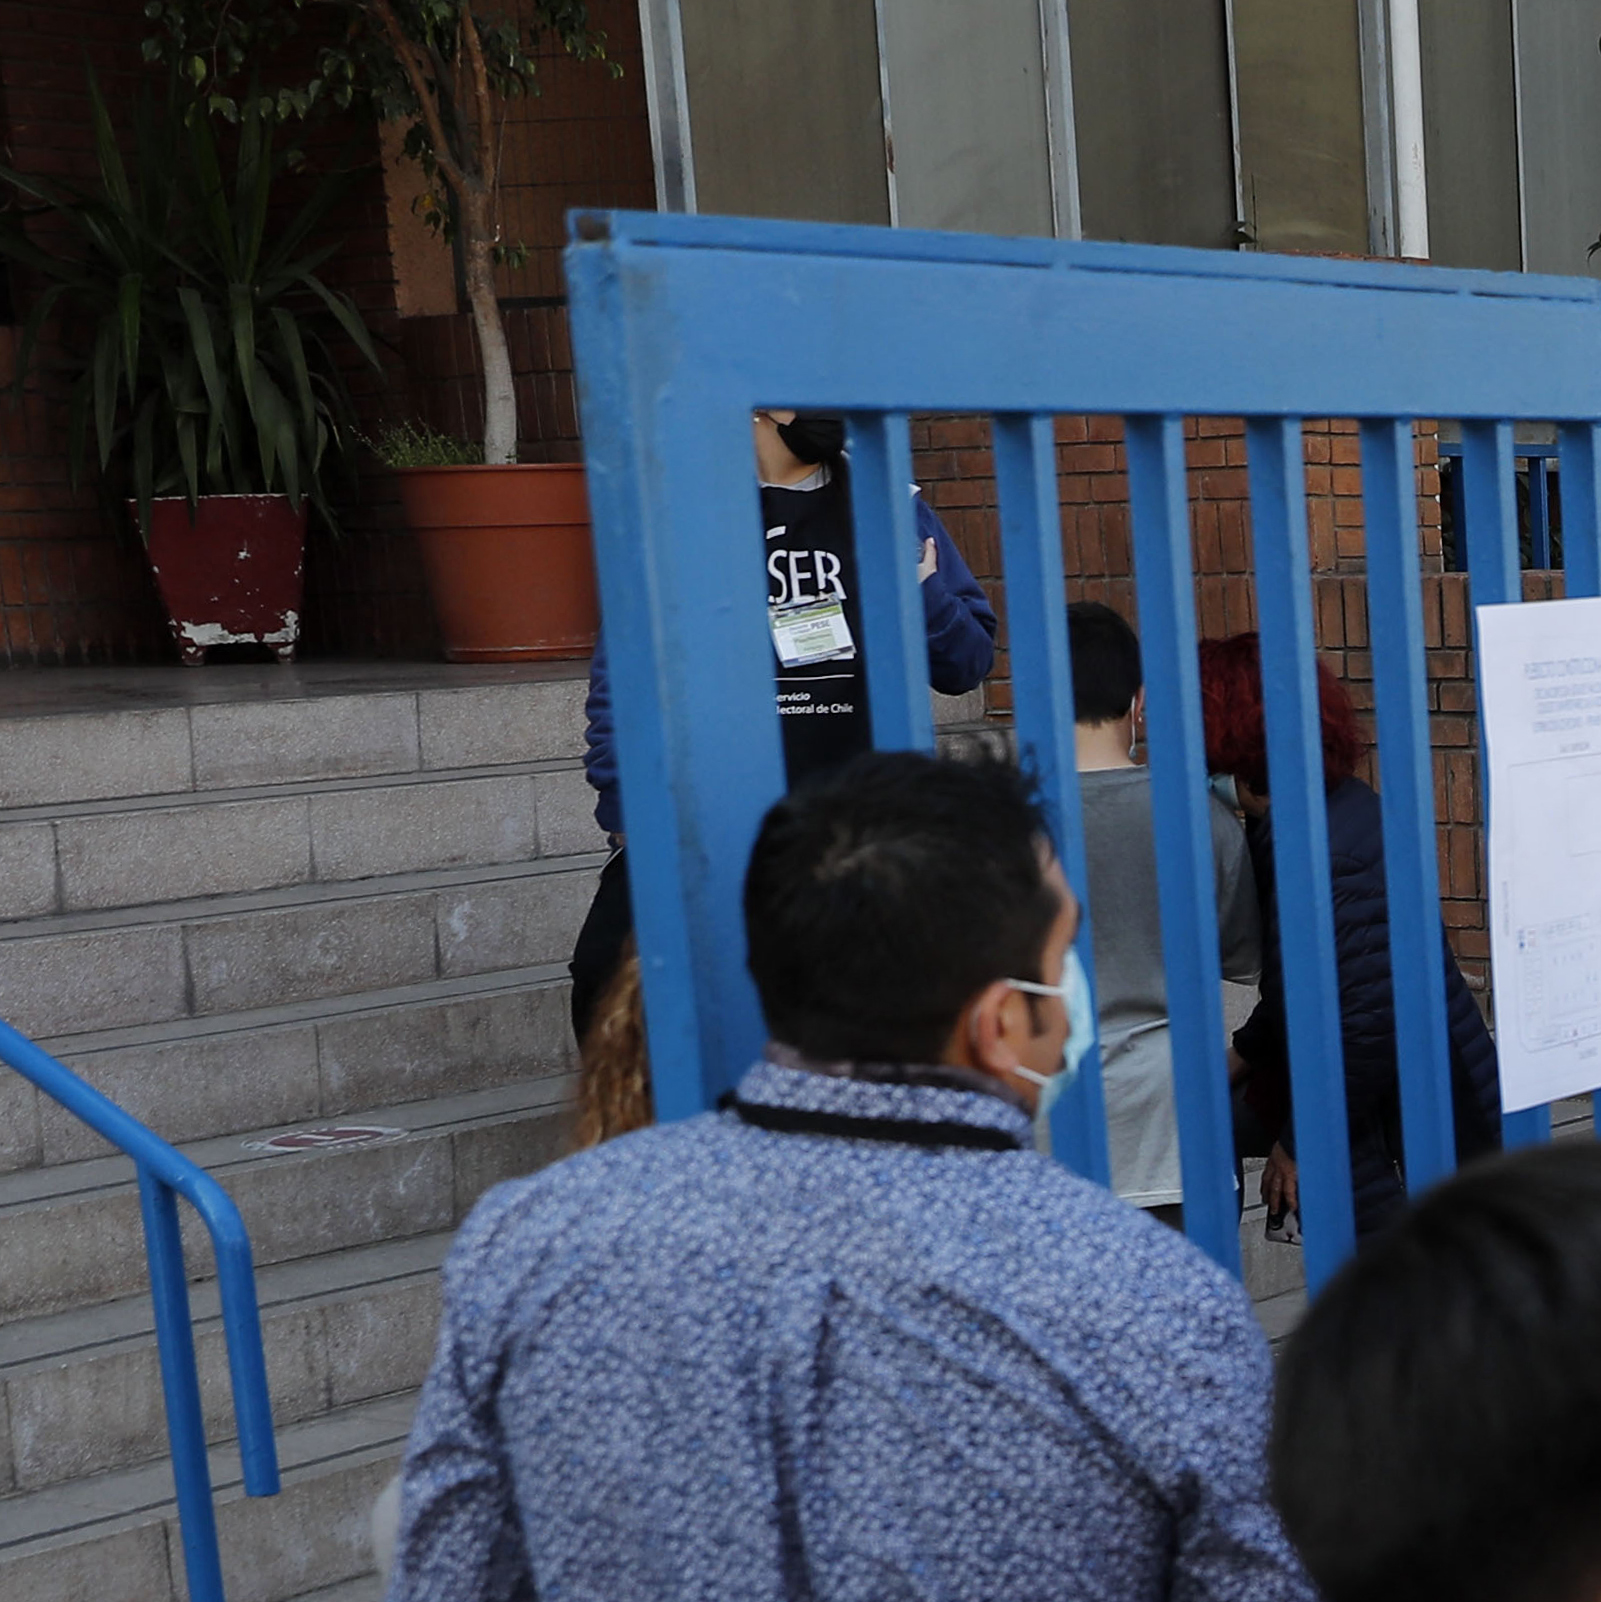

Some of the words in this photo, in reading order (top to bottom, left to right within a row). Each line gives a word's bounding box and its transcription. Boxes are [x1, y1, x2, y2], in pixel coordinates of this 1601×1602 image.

[768, 549, 848, 605] SER
[776, 692, 811, 702] ervicio
[776, 703, 815, 714] lectoral
[816, 704, 830, 714] de
[831, 703, 854, 713] Chile
